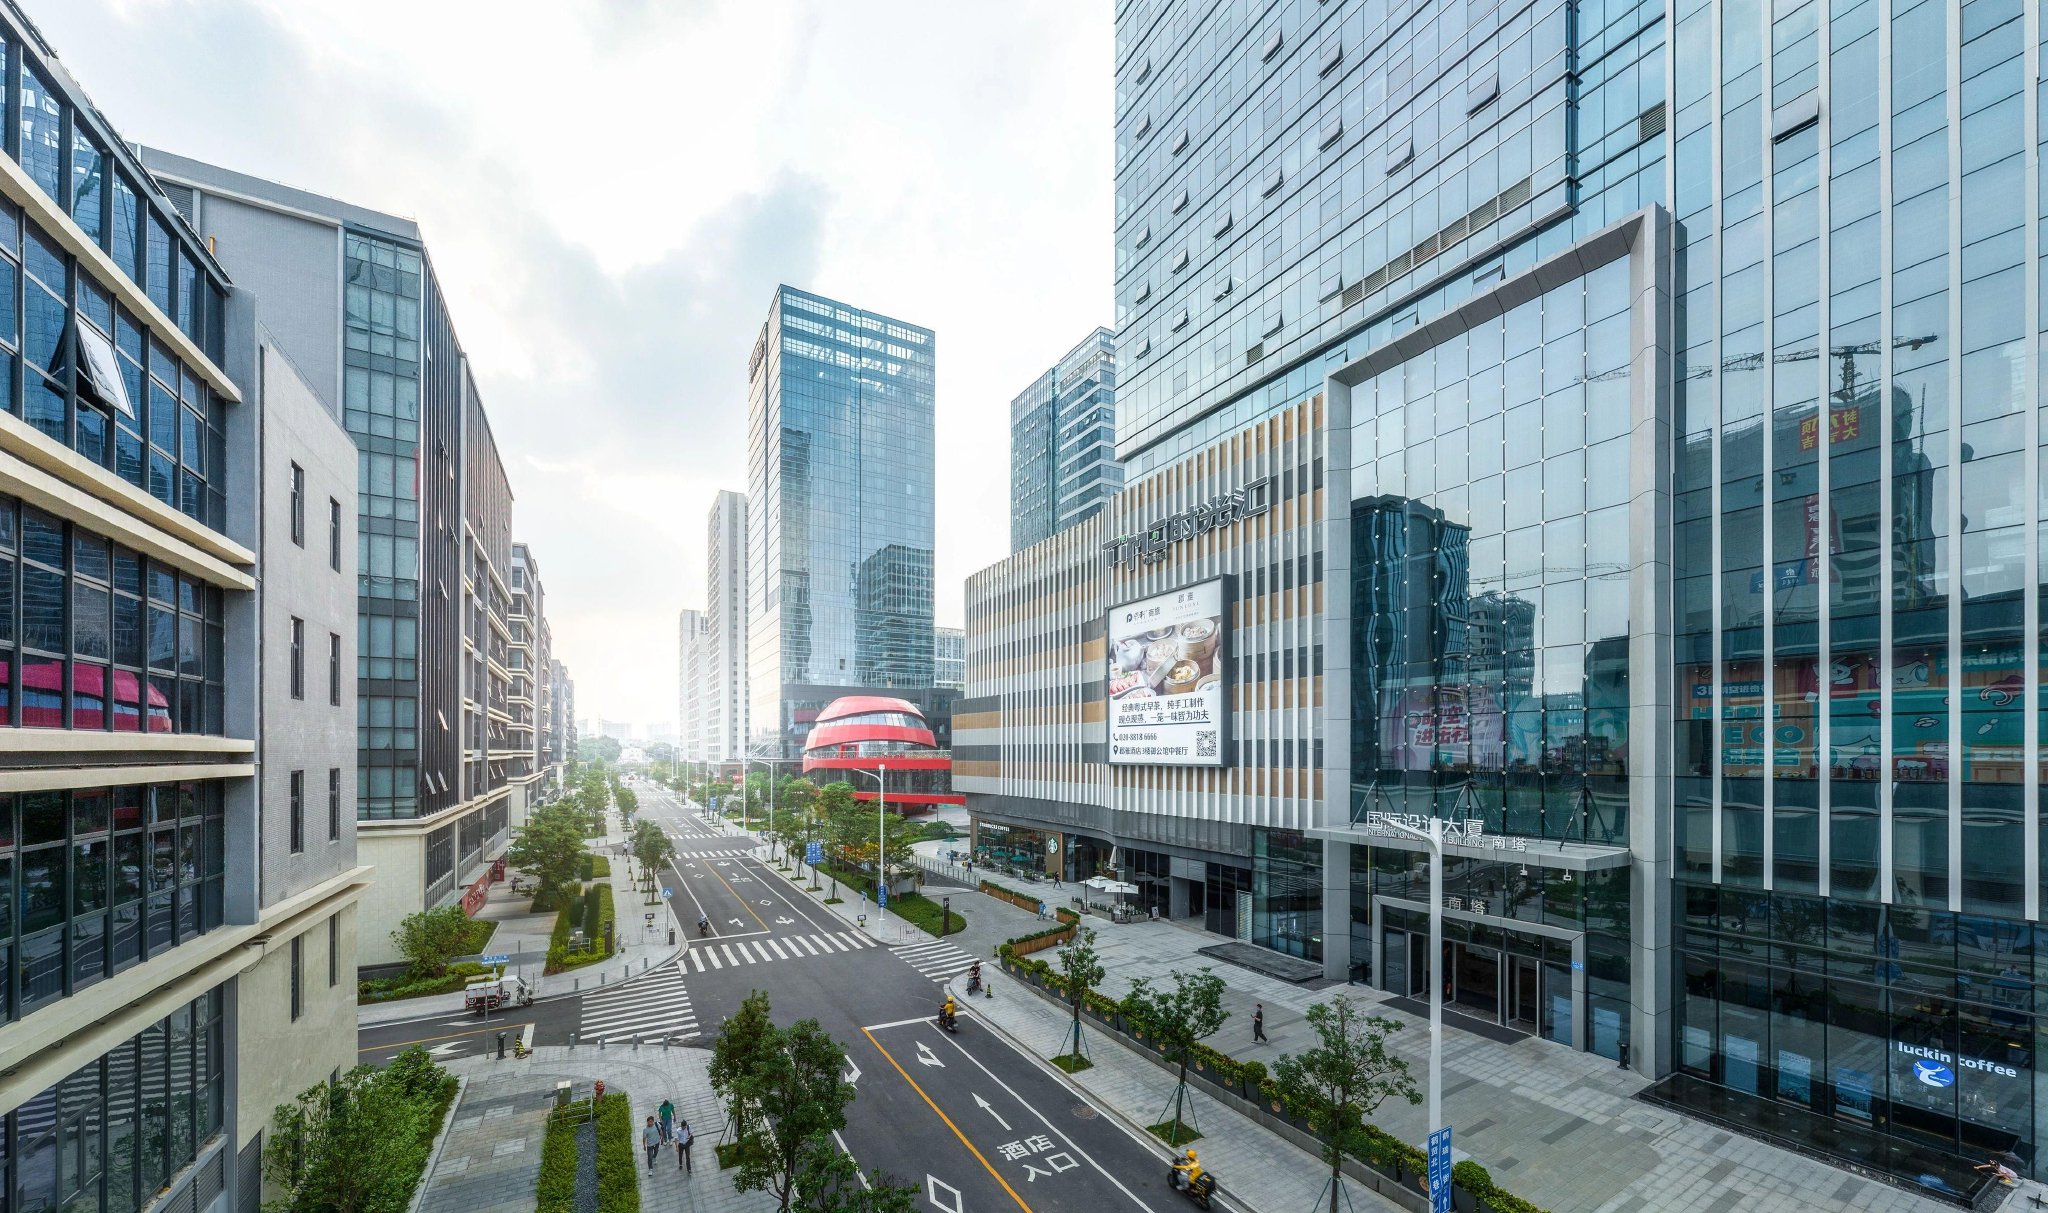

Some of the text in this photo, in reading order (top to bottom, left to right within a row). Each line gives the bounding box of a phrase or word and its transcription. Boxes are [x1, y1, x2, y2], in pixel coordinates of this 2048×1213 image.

[1491, 834, 1528, 852] 南塔
[1449, 896, 1487, 915] 南塔
[1898, 1041, 2017, 1078] luckin coffee
[996, 1134, 1056, 1161] 酒店
[1021, 1151, 1081, 1182] 入口
